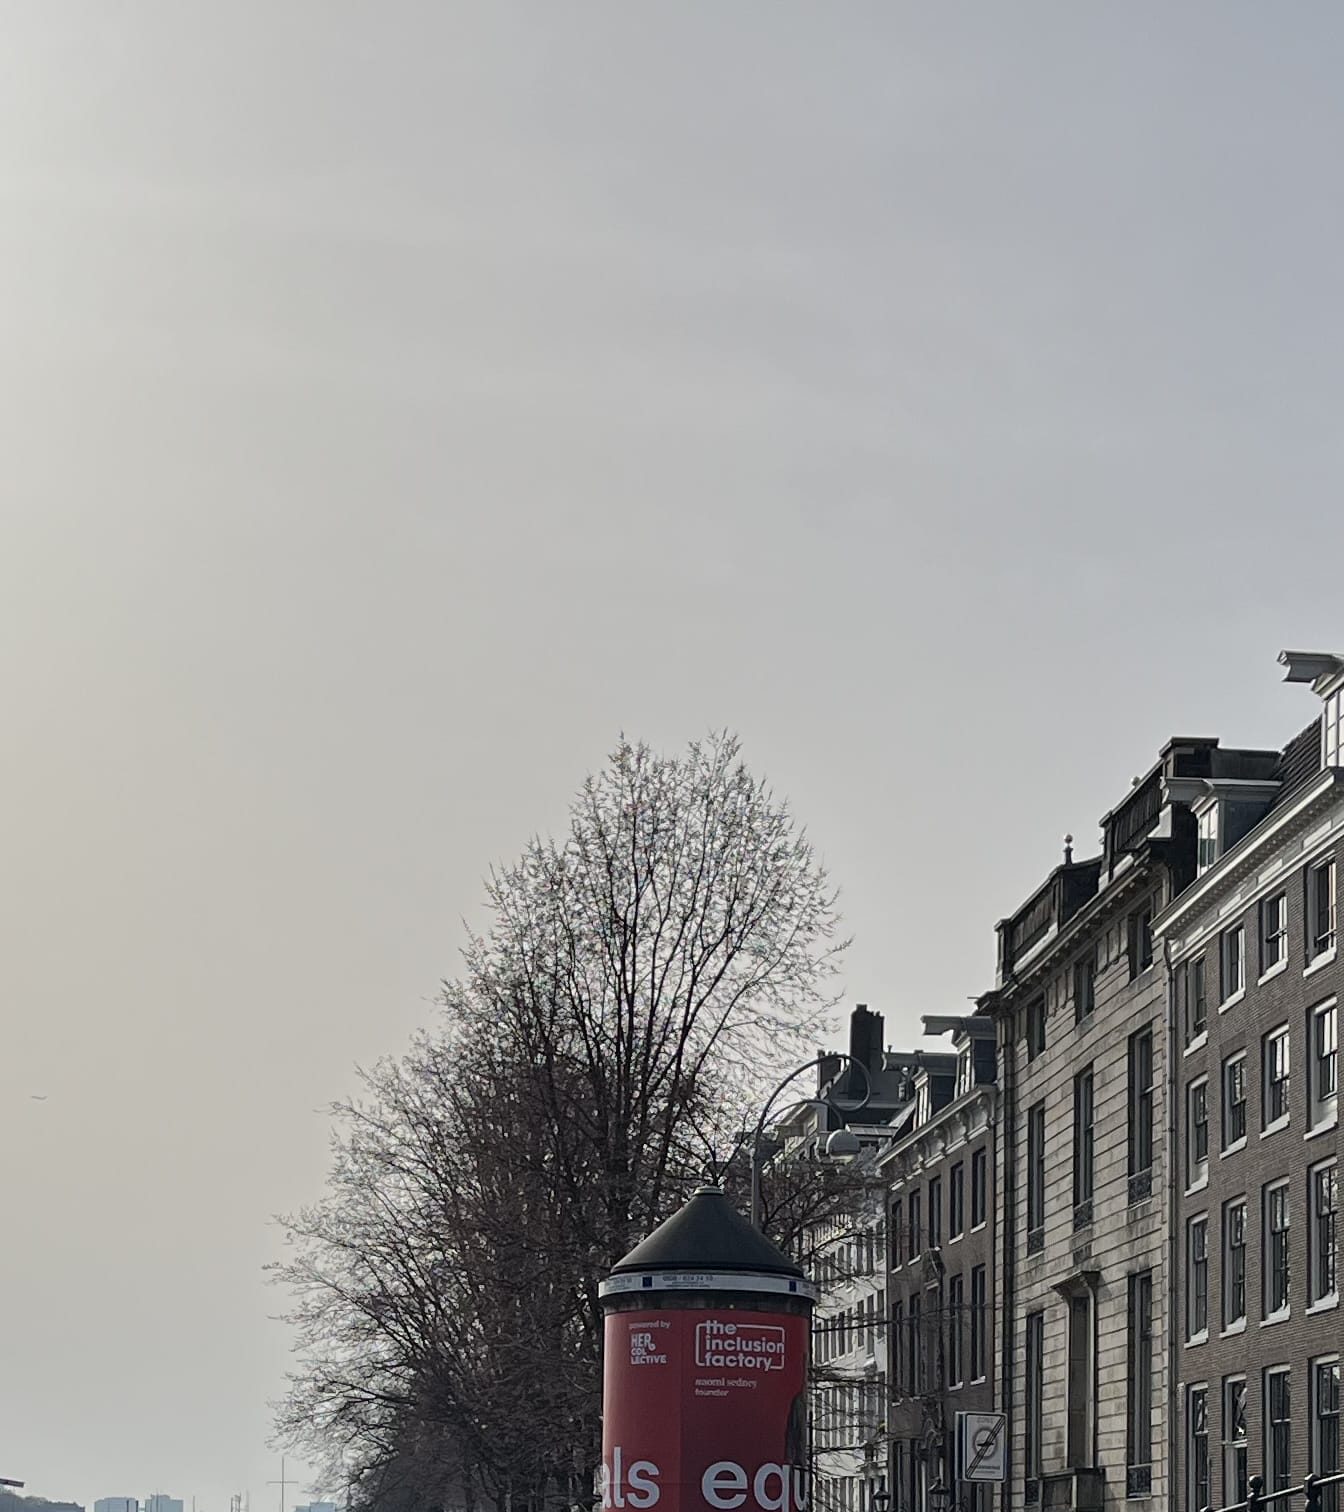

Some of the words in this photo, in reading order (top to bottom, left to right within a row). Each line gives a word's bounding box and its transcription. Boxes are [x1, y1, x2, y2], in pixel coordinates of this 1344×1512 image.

[660, 1320, 671, 1329] by
[705, 1320, 737, 1335] the
[631, 1333, 656, 1351] HER
[705, 1335, 785, 1354] inclusion
[704, 1352, 773, 1371] factory
